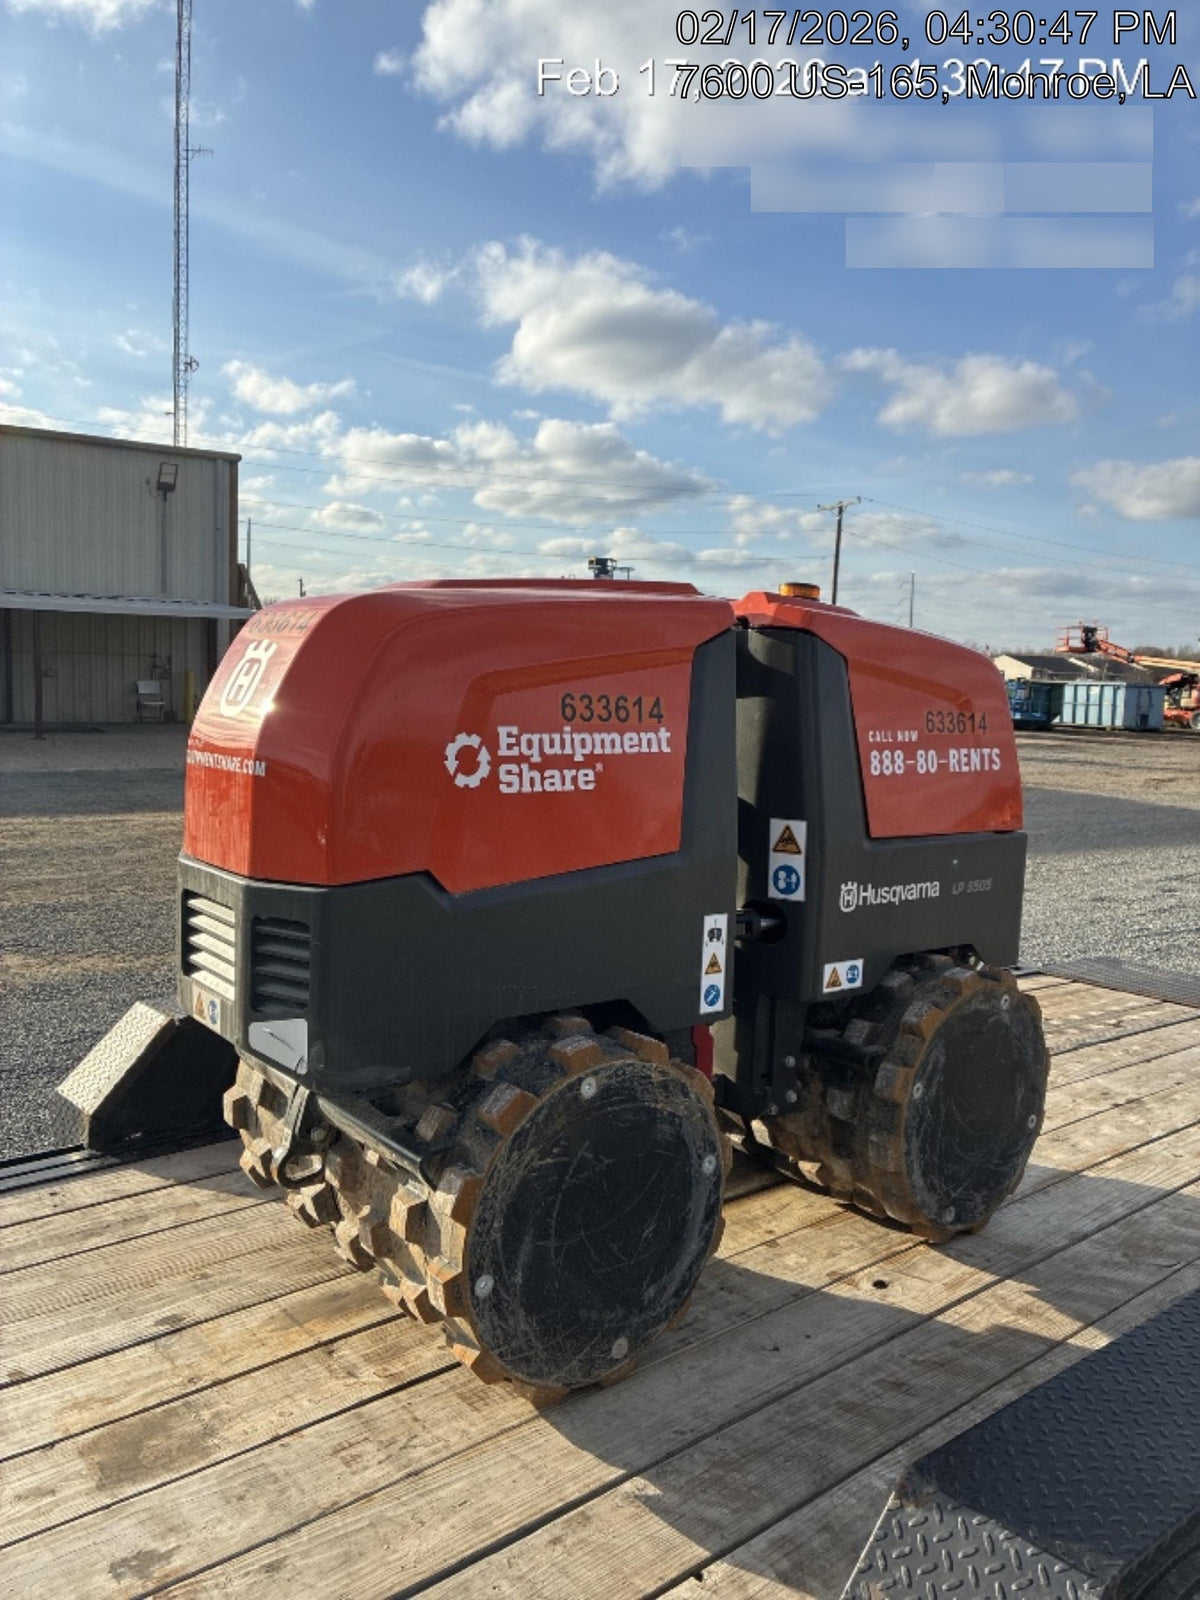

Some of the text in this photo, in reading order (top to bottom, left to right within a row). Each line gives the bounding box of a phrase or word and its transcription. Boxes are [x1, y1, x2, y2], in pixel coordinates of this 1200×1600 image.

[561, 693, 664, 724] 633614
[868, 729, 918, 742] CALL NOW
[925, 711, 988, 734] 633614
[497, 725, 671, 763] Equipment
[870, 748, 1001, 776] 888-80-RENTS
[858, 881, 940, 906] Husqvarna
